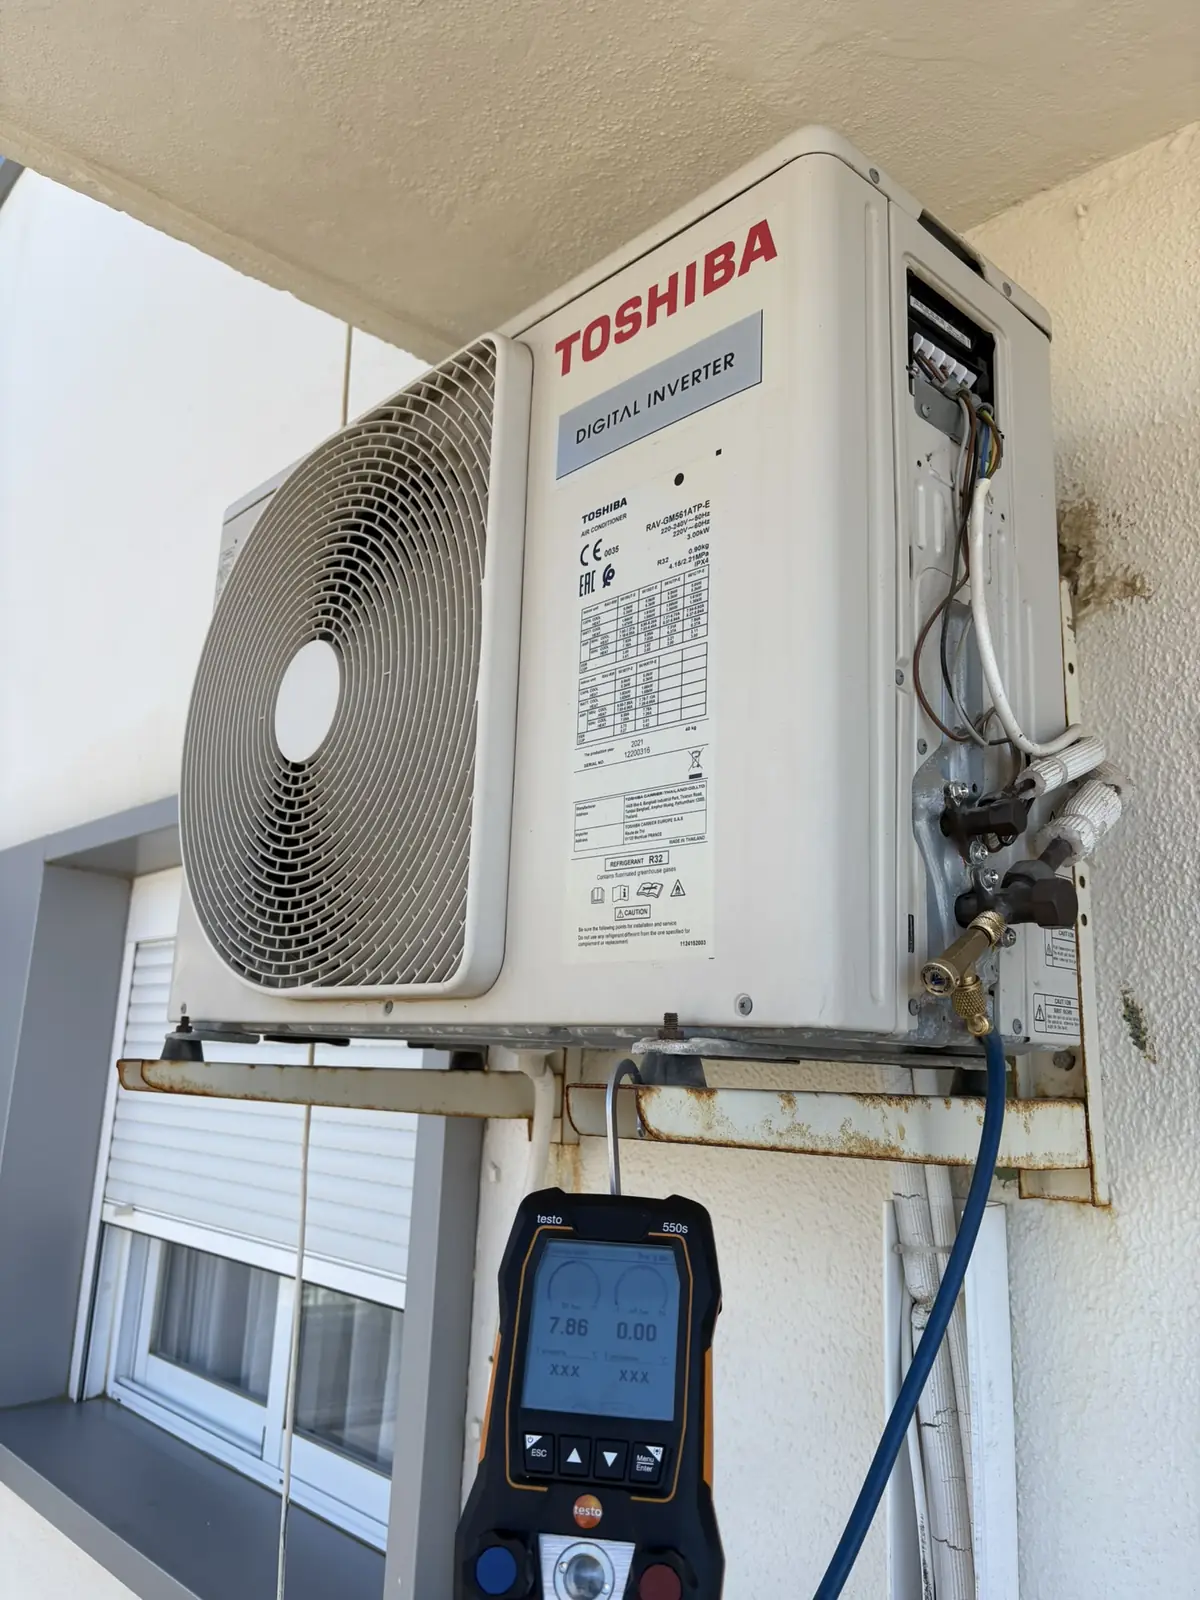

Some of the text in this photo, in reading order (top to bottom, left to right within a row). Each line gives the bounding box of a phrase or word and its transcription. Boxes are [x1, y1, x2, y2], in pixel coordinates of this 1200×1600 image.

[555, 219, 778, 377] TOSHIBA
[575, 352, 735, 444] DIGITAL INVERTER
[581, 497, 628, 524] TOSHIBA
[646, 500, 710, 532] RAV-GM561ATP-E
[581, 513, 627, 538] AIR CONDITIONER
[580, 538, 619, 566] CE 0035
[579, 570, 596, 597] EAC
[631, 739, 643, 748] 2021
[624, 746, 651, 758] 12200316
[610, 854, 663, 868] REFRIGERANT R32
[637, 868, 662, 876] greenhouse
[624, 908, 648, 917] CAUTION
[537, 1214, 563, 1225] testo
[662, 1222, 689, 1234] 550s
[549, 1316, 589, 1337] 7.86
[616, 1321, 657, 1342] 0.00
[531, 1448, 547, 1458] ESC
[636, 1454, 655, 1463] Menu
[636, 1463, 654, 1473] Enter
[573, 1505, 603, 1517] testo
